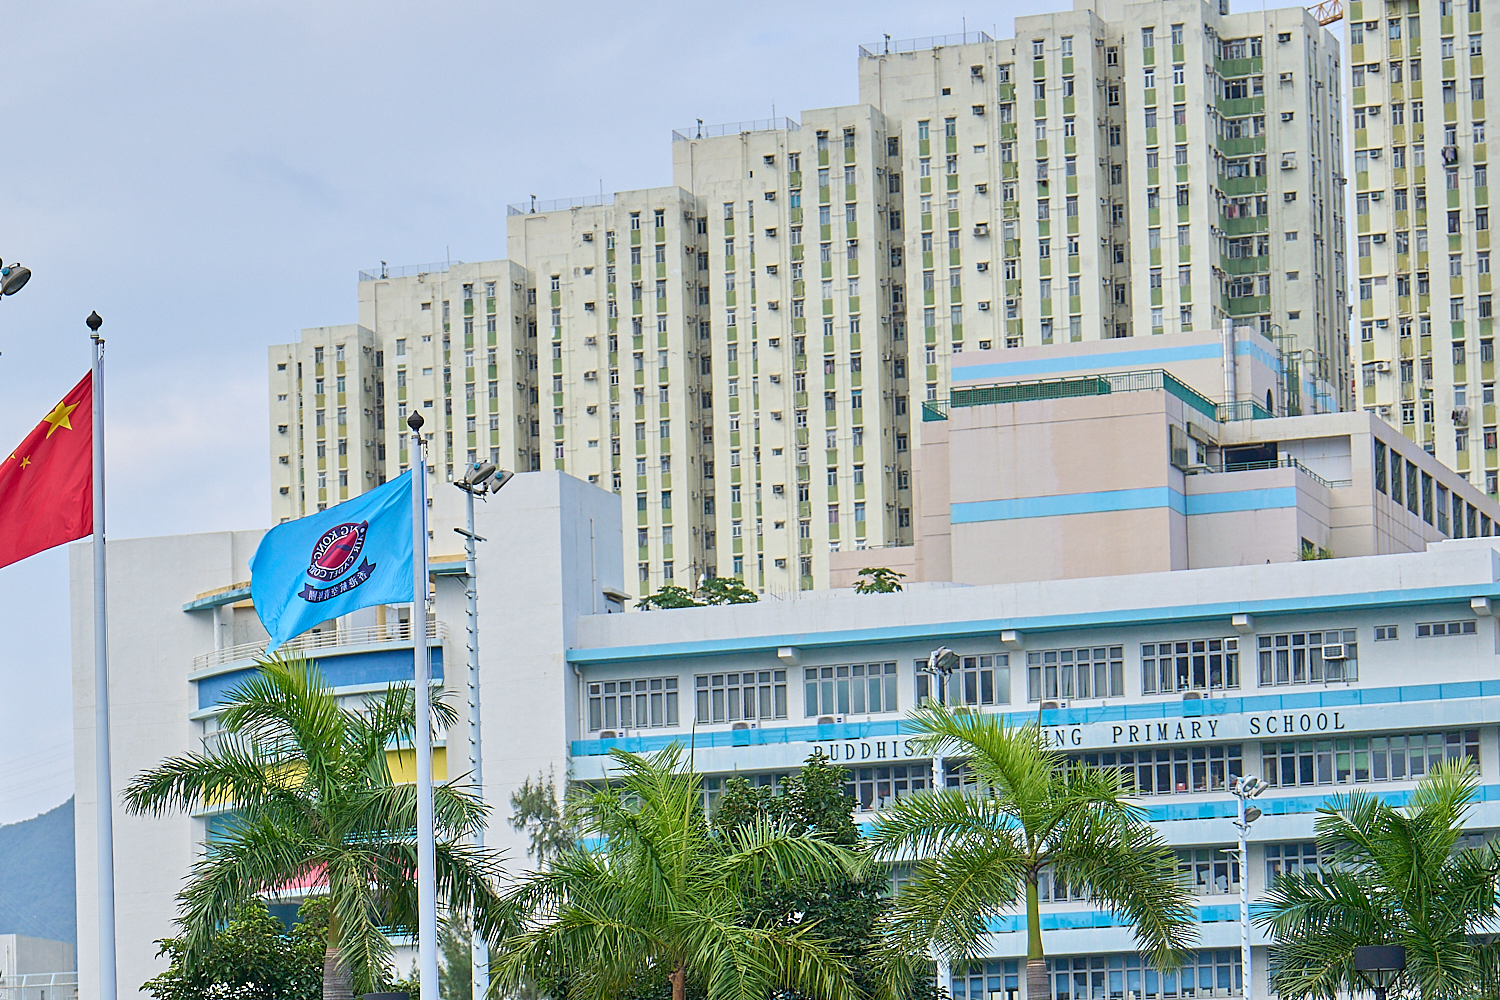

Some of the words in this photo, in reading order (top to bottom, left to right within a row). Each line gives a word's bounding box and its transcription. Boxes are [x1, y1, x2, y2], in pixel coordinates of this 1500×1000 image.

[813, 737, 932, 761] BUDDHIS
[1112, 719, 1218, 743] PRIMARY
[1250, 712, 1345, 735] SCHOOL
